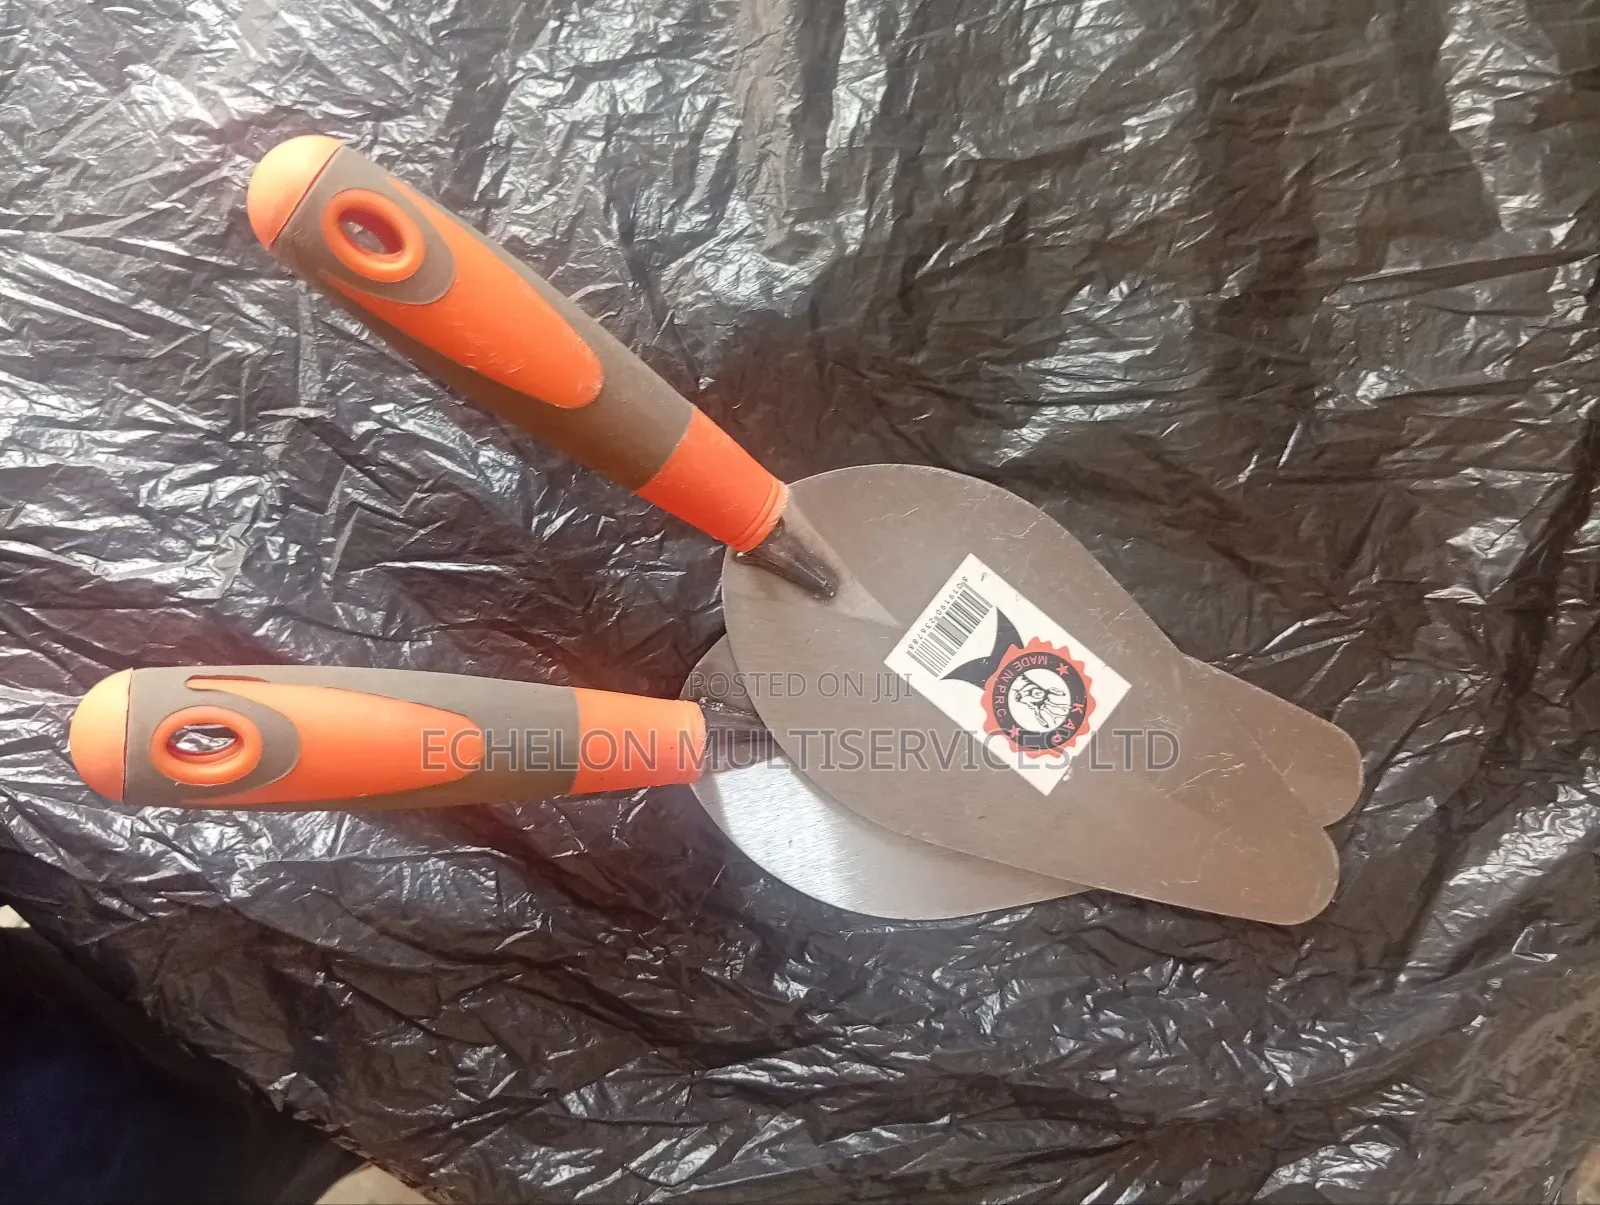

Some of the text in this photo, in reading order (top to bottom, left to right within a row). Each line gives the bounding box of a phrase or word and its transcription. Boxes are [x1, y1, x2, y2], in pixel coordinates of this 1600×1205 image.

[1012, 655, 1048, 672] MADE
[1001, 669, 1015, 683] IN
[1053, 702, 1085, 743] KAP
